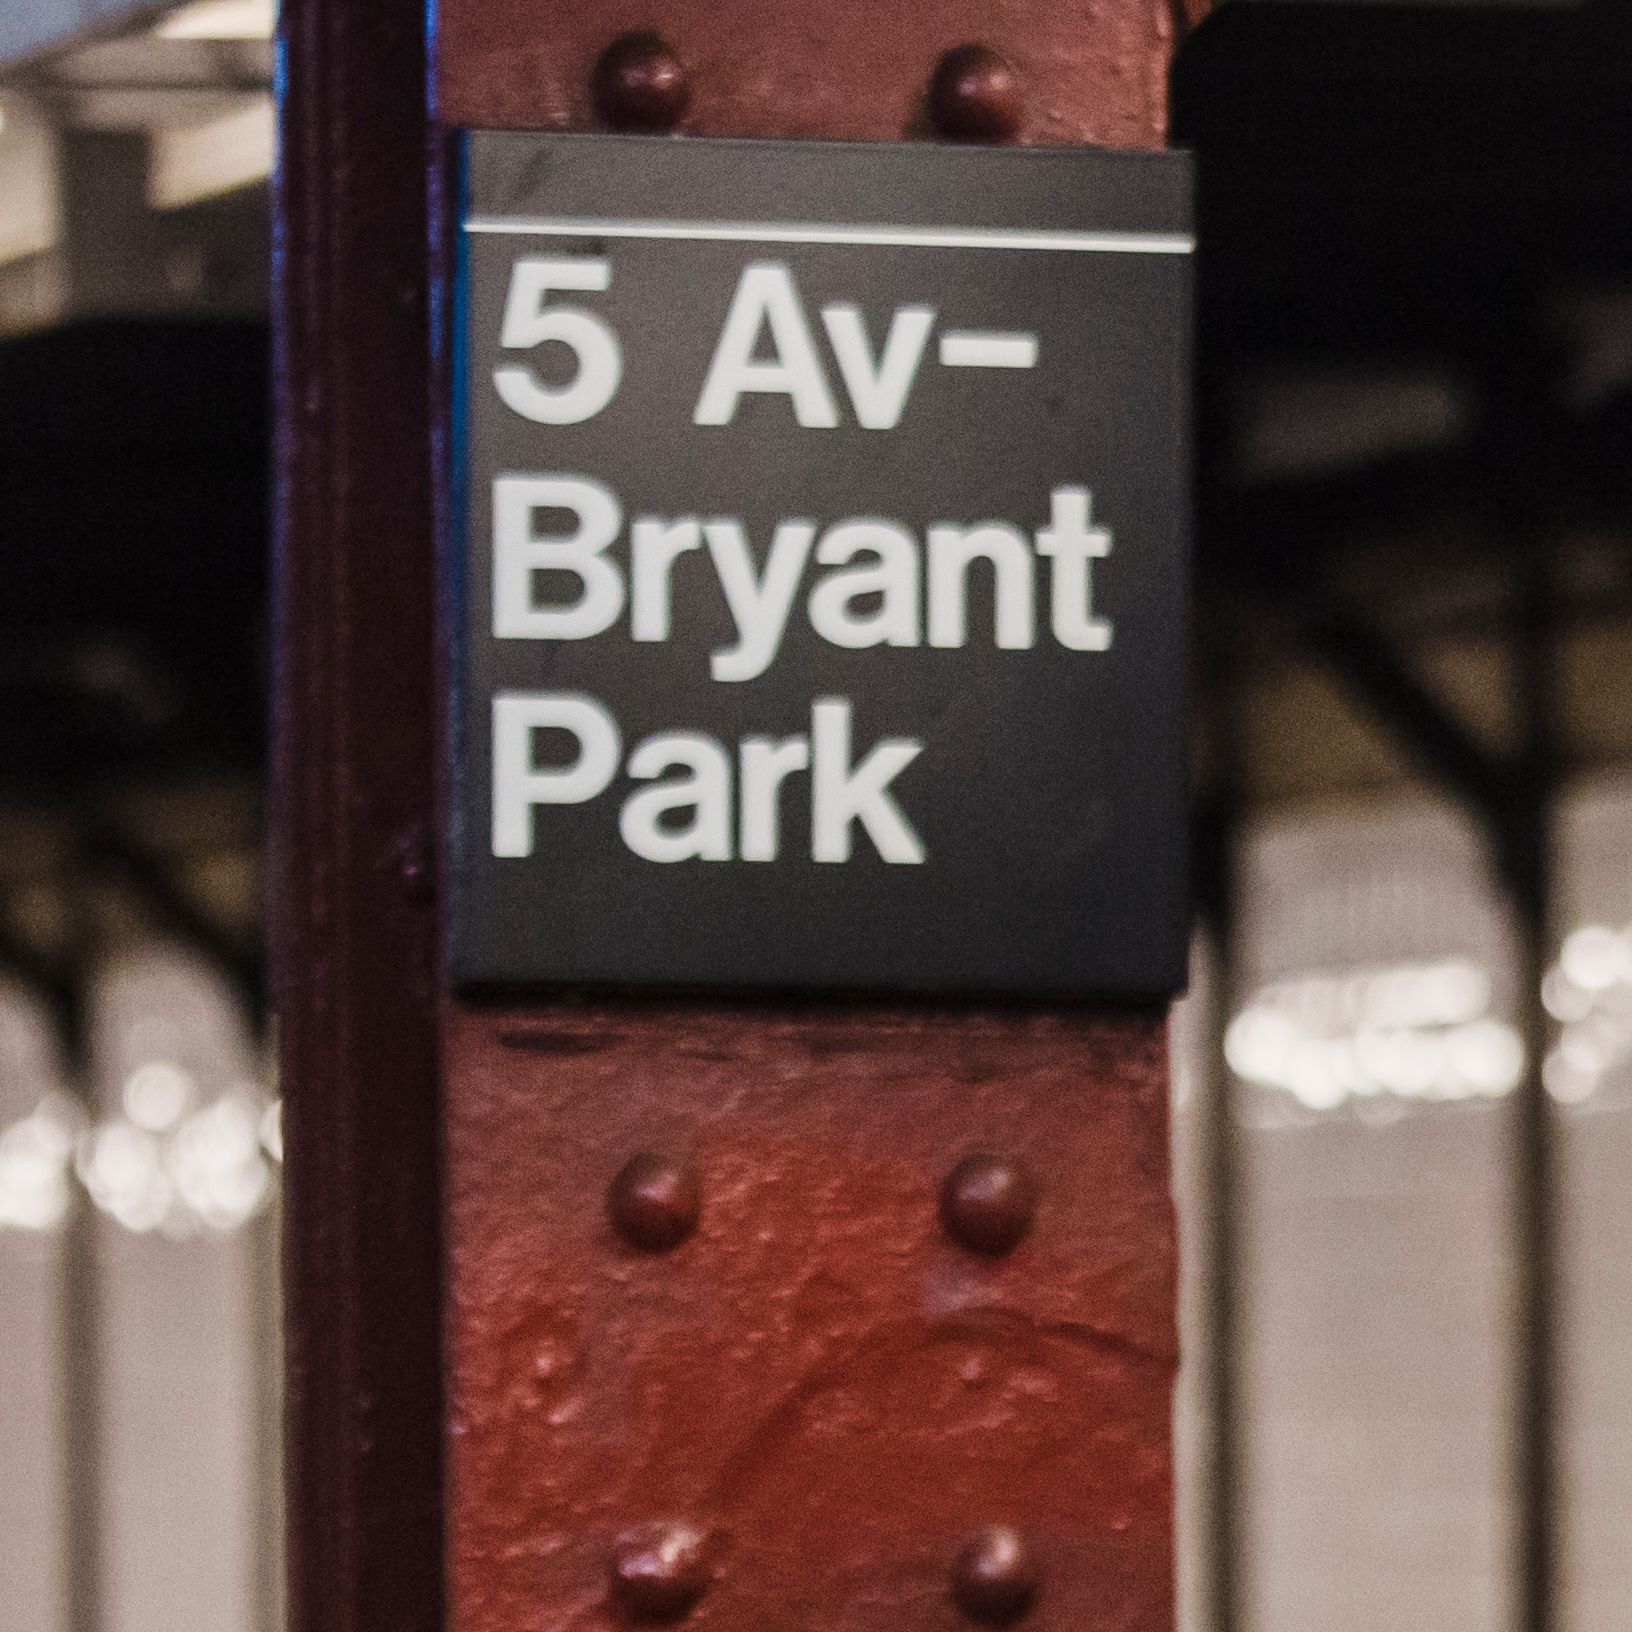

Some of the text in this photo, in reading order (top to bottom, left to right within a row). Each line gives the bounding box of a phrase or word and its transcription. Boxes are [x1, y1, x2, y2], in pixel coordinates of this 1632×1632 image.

[491, 253, 624, 425] 5
[491, 471, 1112, 683] Bryant
[491, 692, 925, 866] Park
